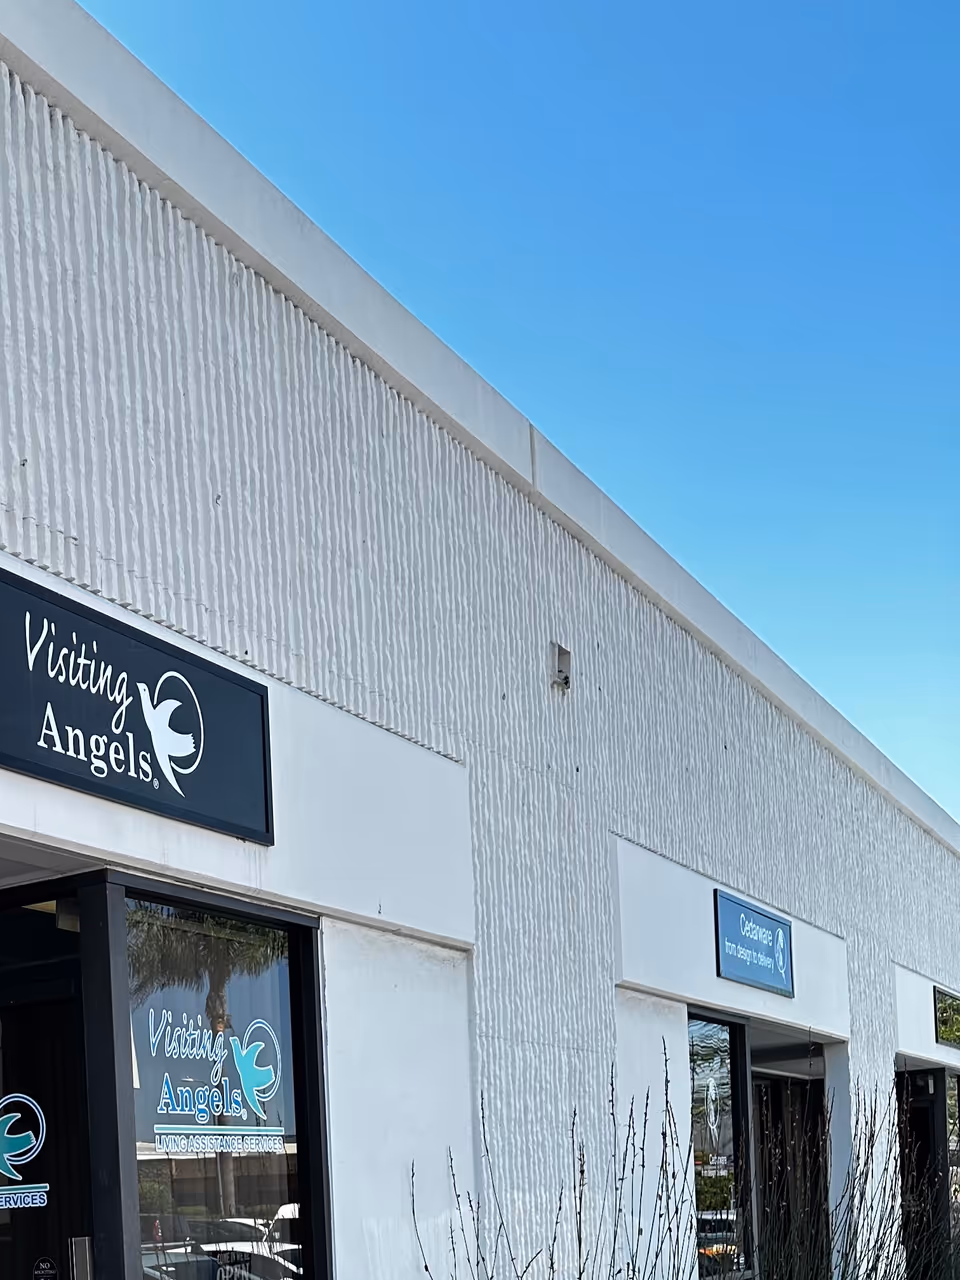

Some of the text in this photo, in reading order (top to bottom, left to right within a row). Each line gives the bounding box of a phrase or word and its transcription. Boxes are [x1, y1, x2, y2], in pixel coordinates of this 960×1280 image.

[25, 611, 133, 734] Visiting
[740, 913, 773, 946] Cedarware
[725, 936, 775, 974] from design to delivery
[149, 1008, 228, 1085] Visiting
[155, 1135, 283, 1153] LIVING ASSISTANCE SERVICES
